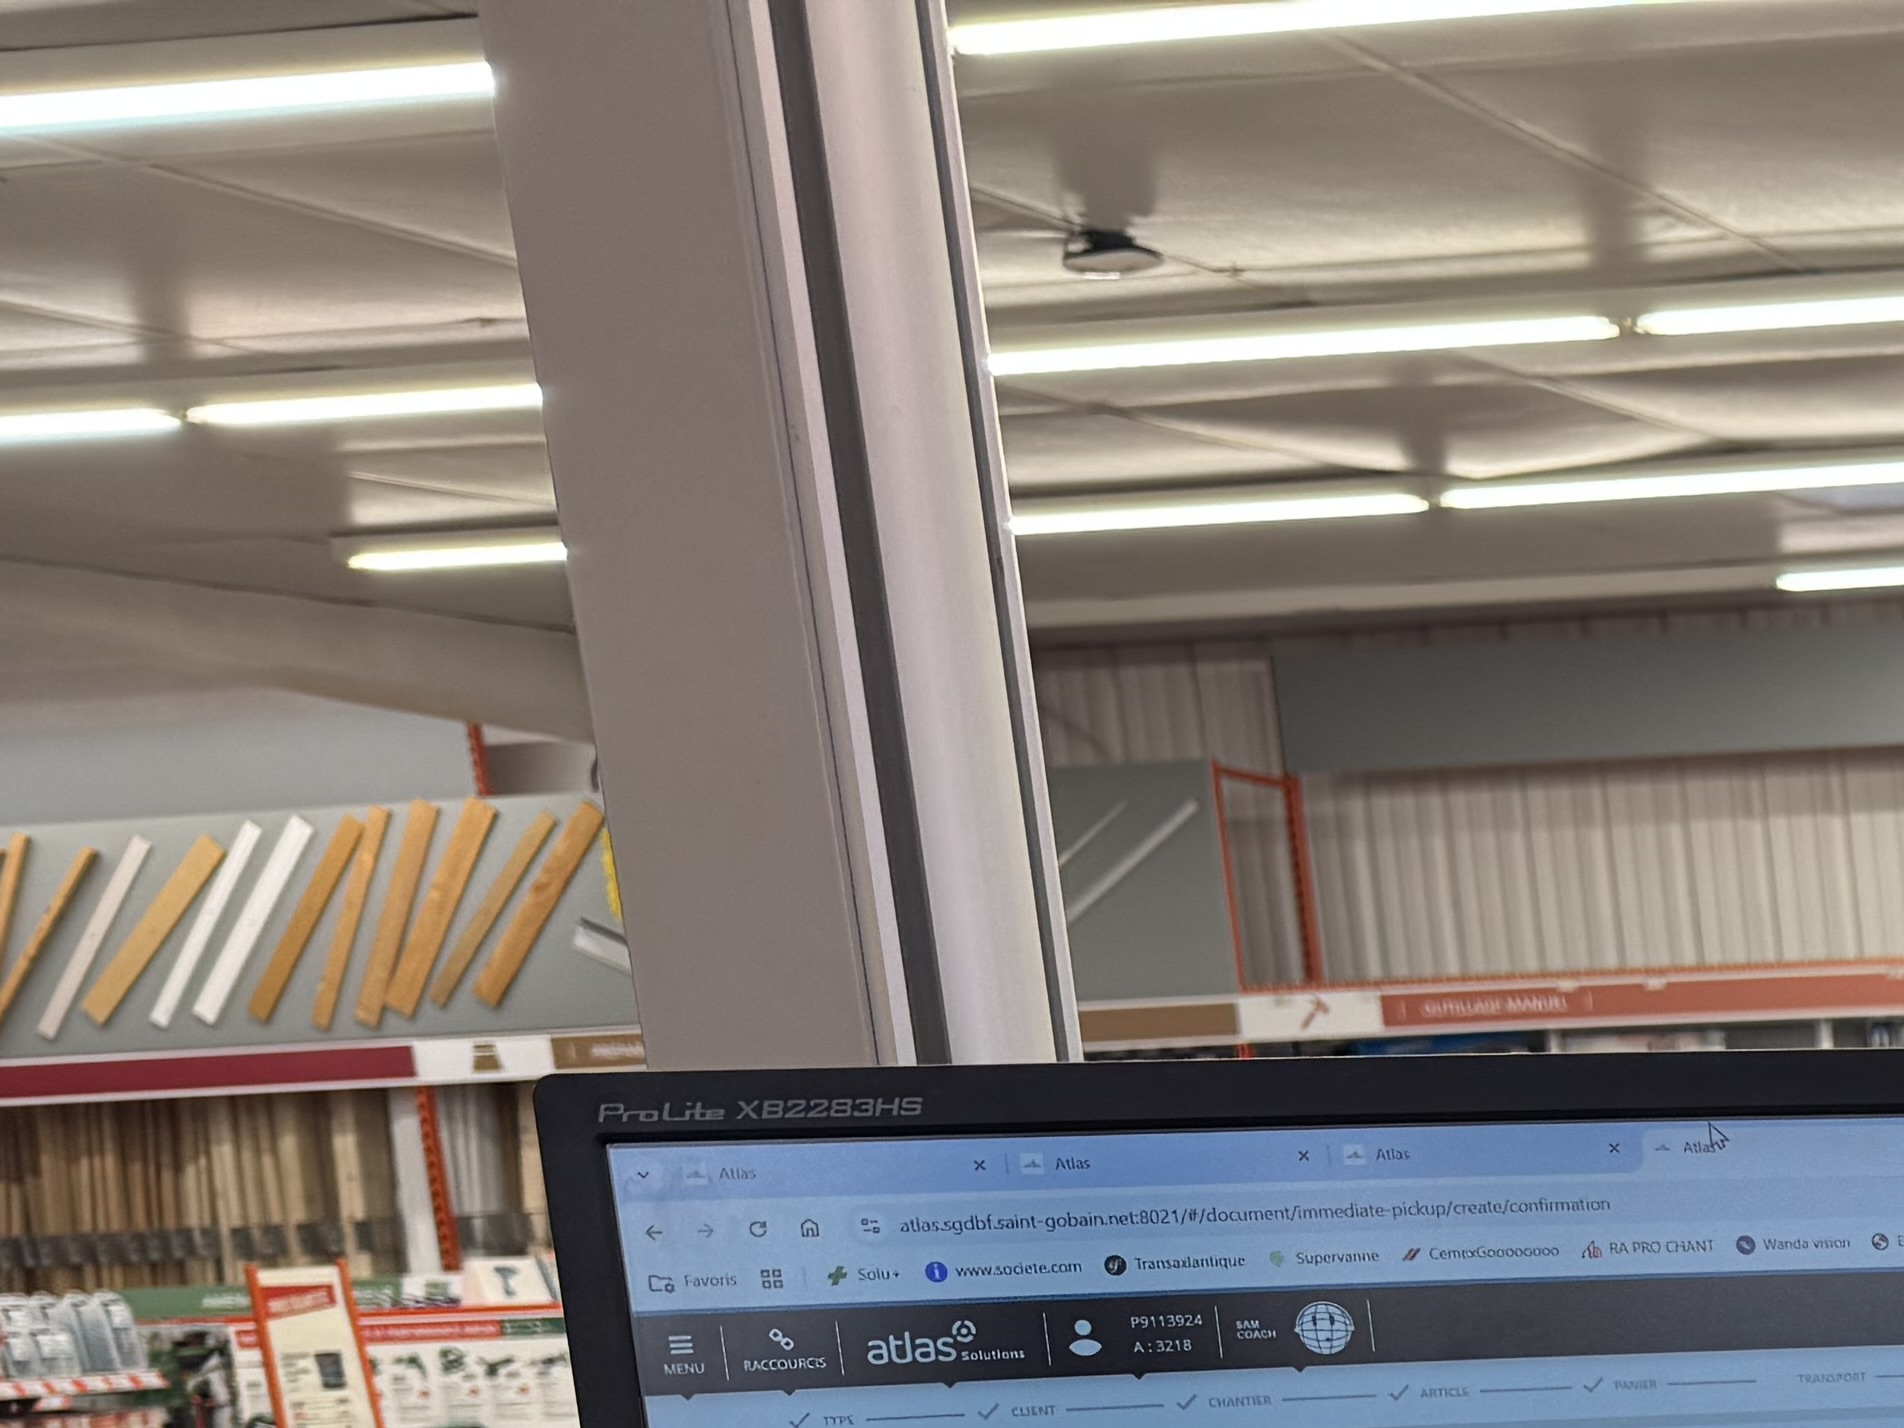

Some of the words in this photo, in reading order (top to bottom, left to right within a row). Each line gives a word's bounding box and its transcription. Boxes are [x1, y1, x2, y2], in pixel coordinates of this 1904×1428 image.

[599, 1102, 725, 1123] ProLite
[736, 1097, 923, 1120] XB2283HS
[1055, 1156, 1091, 1171] Atlas
[684, 1273, 737, 1287] Favoris
[1130, 1314, 1203, 1329] P9113924
[867, 1331, 957, 1365] atlas
[961, 1348, 1025, 1362] Solutions
[664, 1362, 705, 1375] MENU
